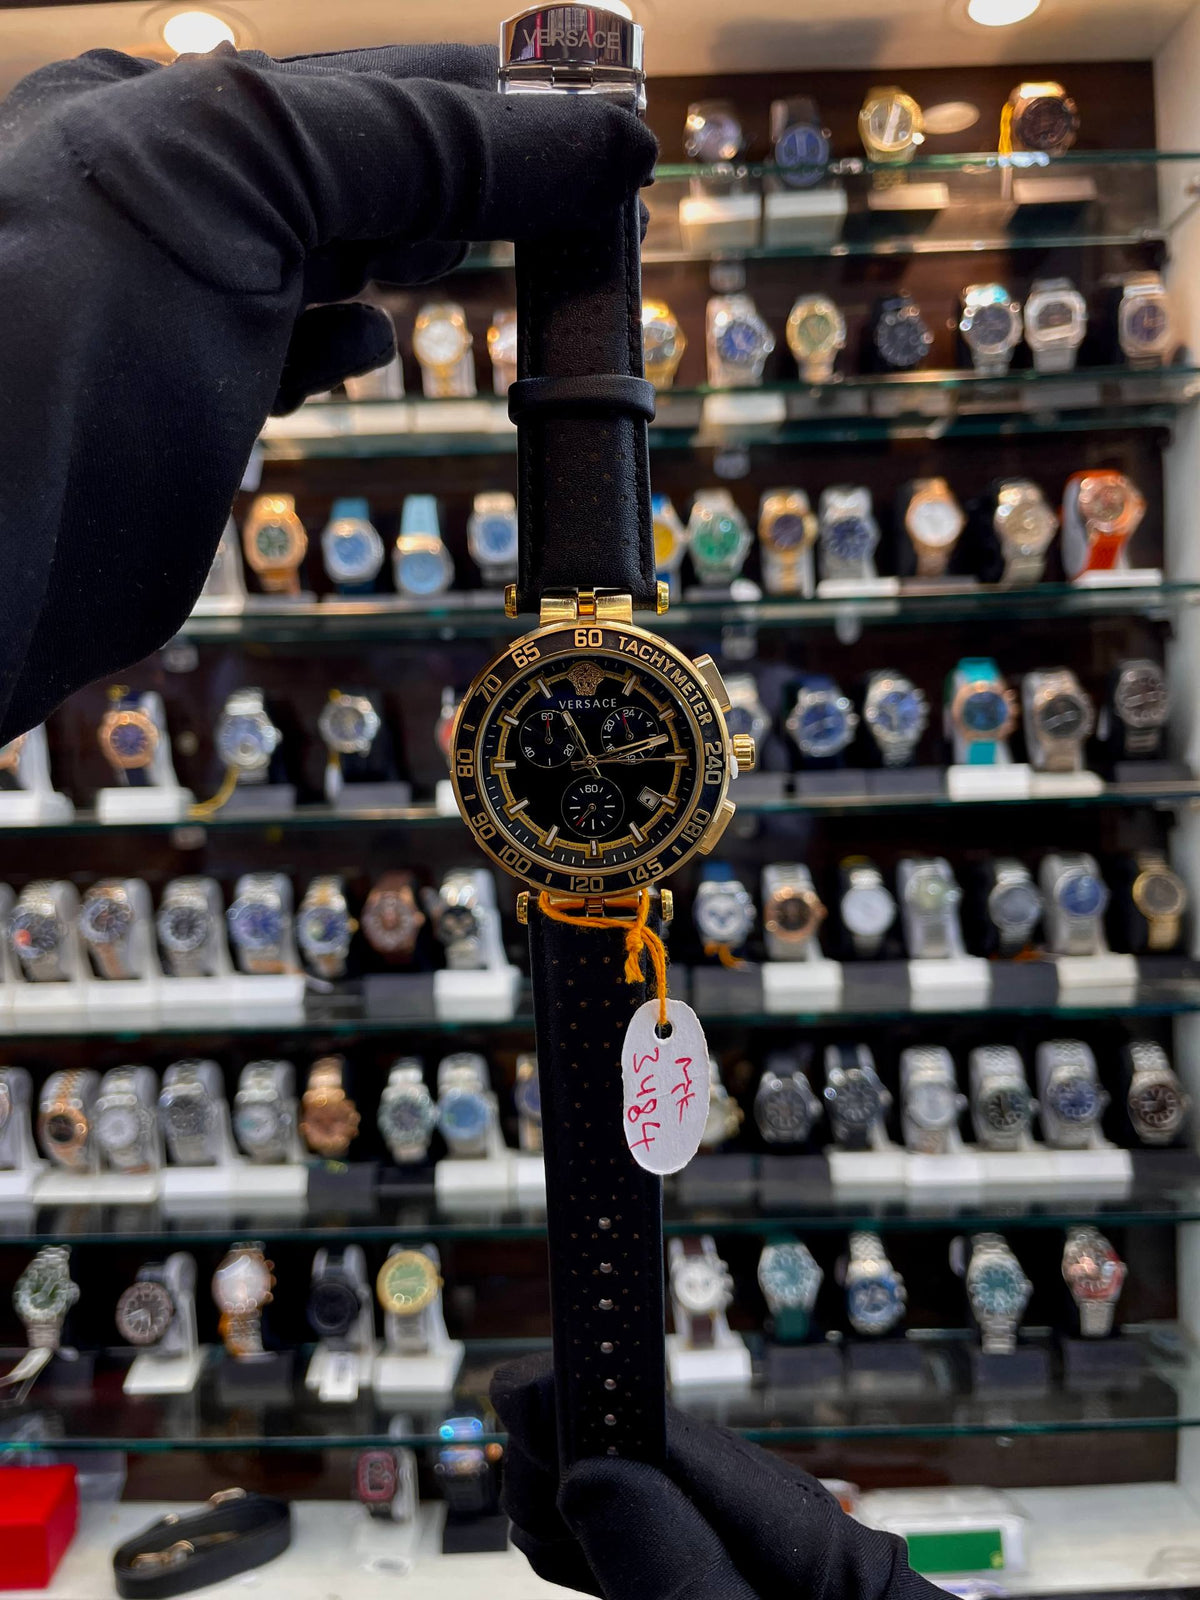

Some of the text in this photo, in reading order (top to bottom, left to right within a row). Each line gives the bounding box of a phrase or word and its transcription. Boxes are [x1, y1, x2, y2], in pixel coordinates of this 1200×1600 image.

[523, 29, 621, 50] VERSACE
[574, 629, 603, 648] 60
[511, 641, 541, 669] 65
[475, 674, 502, 703] 70
[618, 635, 713, 726] TACHYMETER
[558, 698, 617, 710] VERSACE
[622, 709, 635, 718] 24
[541, 712, 554, 721] 60
[604, 719, 615, 732] 20
[524, 746, 536, 758] 40
[563, 743, 575, 757] 20
[456, 748, 474, 778] 80
[704, 741, 723, 785] 240
[584, 784, 599, 793] 60
[471, 811, 497, 840] 90
[680, 808, 711, 844] 180
[497, 844, 533, 875] 100
[628, 857, 664, 885] 145
[570, 876, 604, 893] 120
[627, 1046, 661, 1153] 3484
